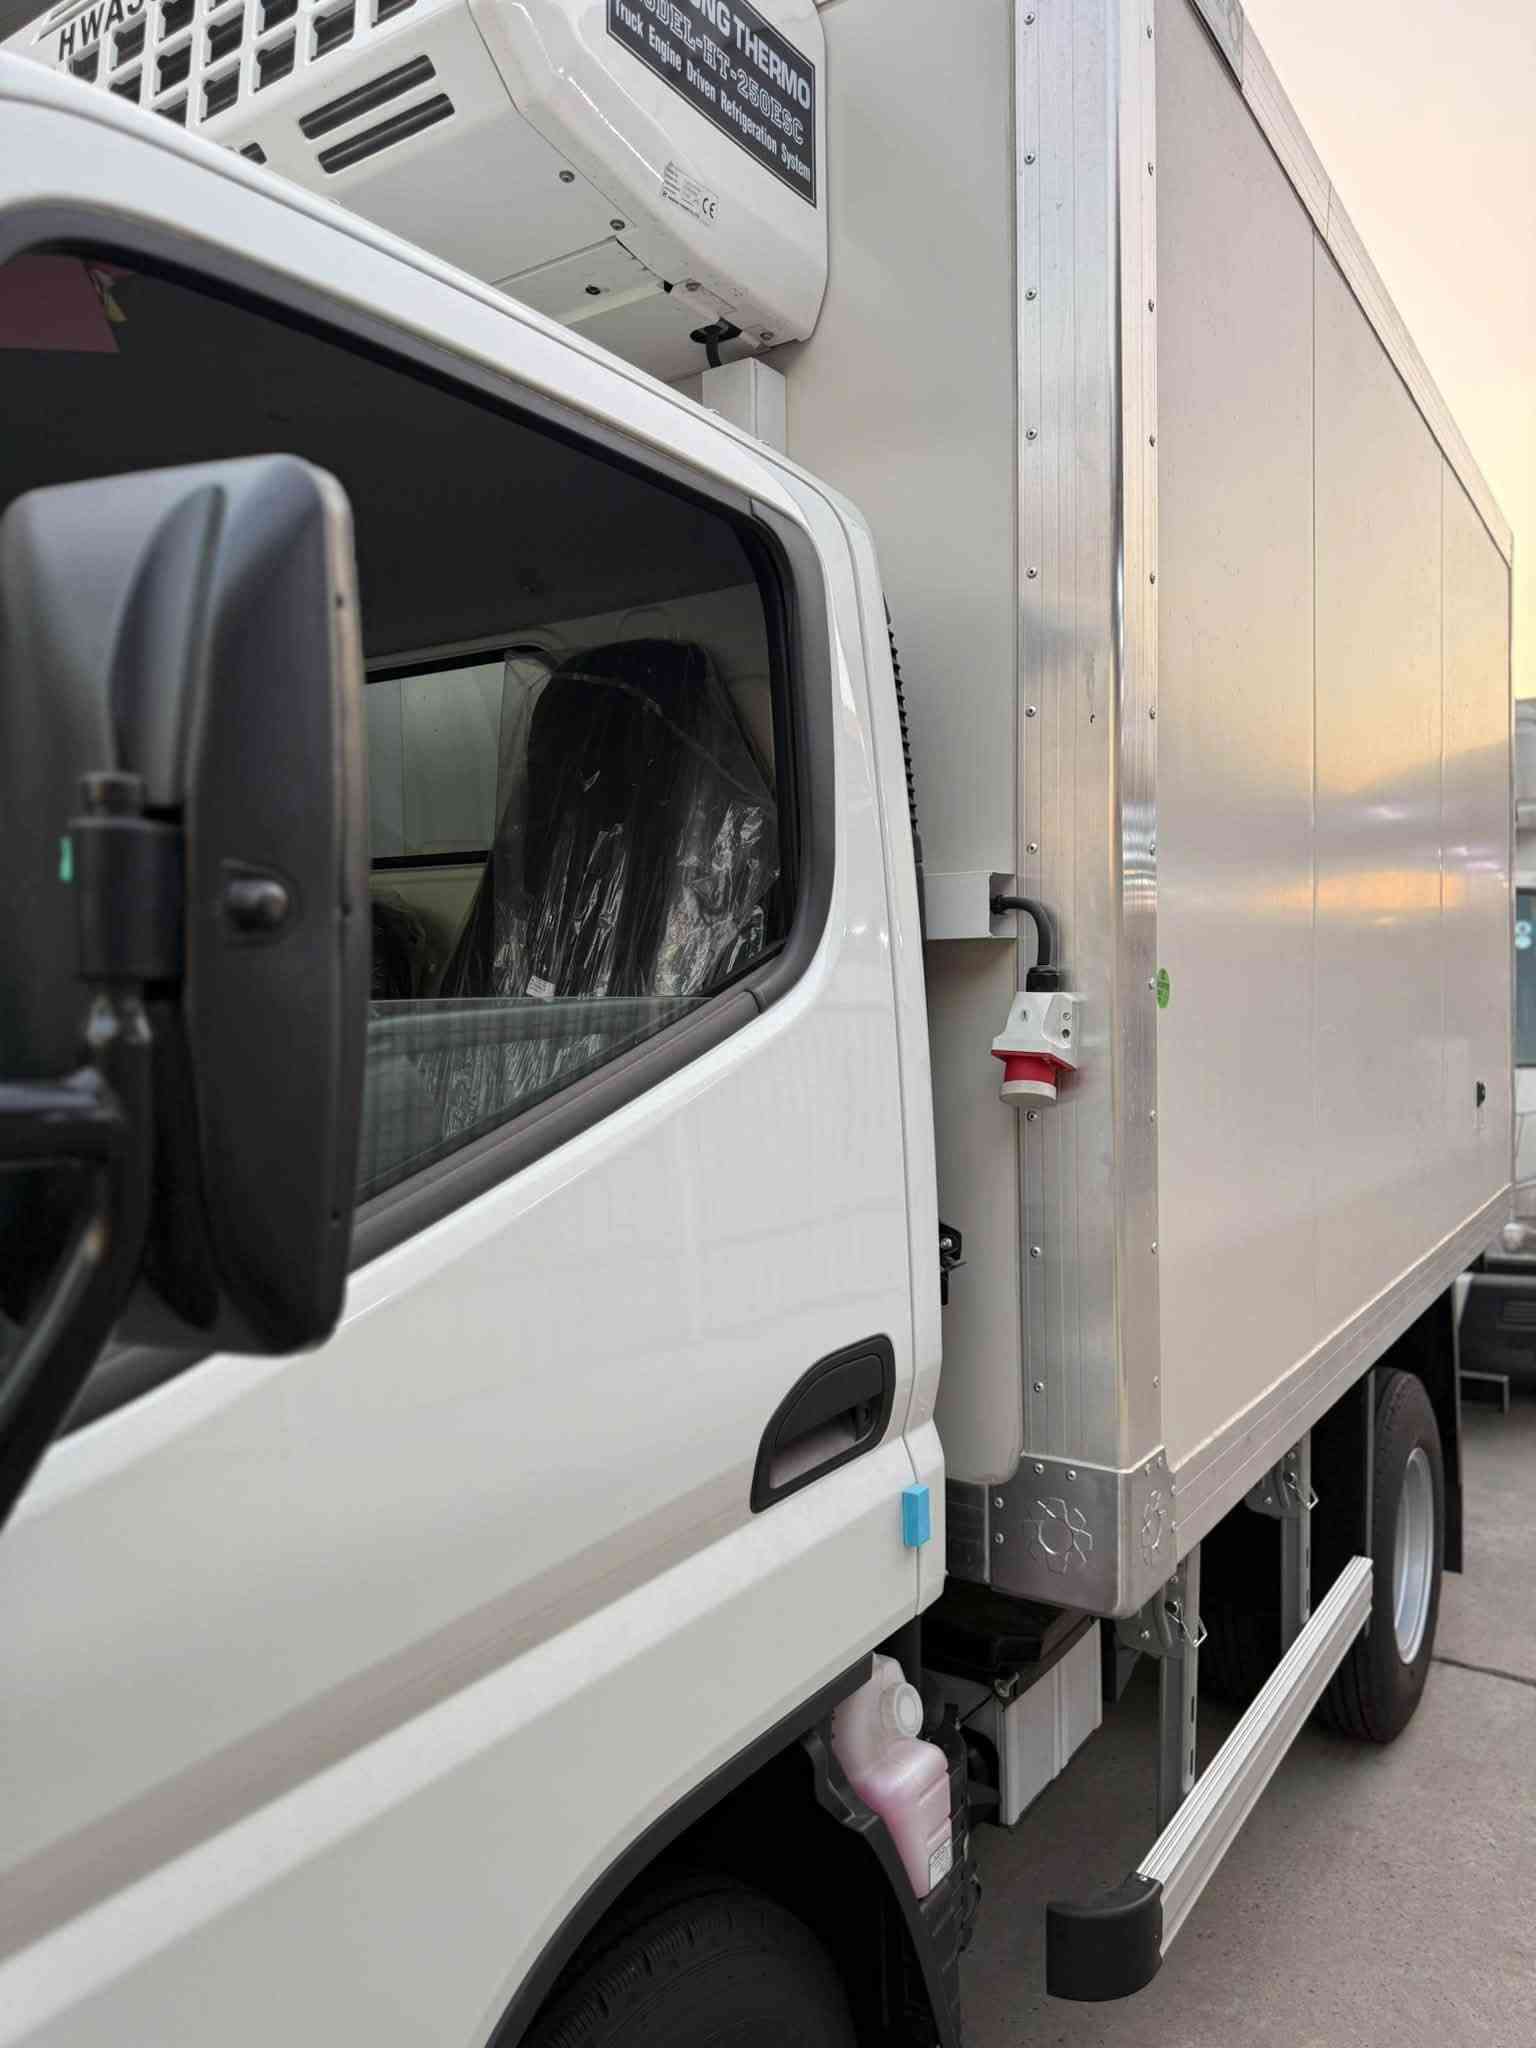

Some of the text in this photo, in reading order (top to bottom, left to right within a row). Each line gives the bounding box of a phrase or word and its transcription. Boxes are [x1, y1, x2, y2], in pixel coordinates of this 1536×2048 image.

[615, 0, 811, 184] Truck Engine Driven Refrigeration System
[733, 15, 811, 110] THERMO
